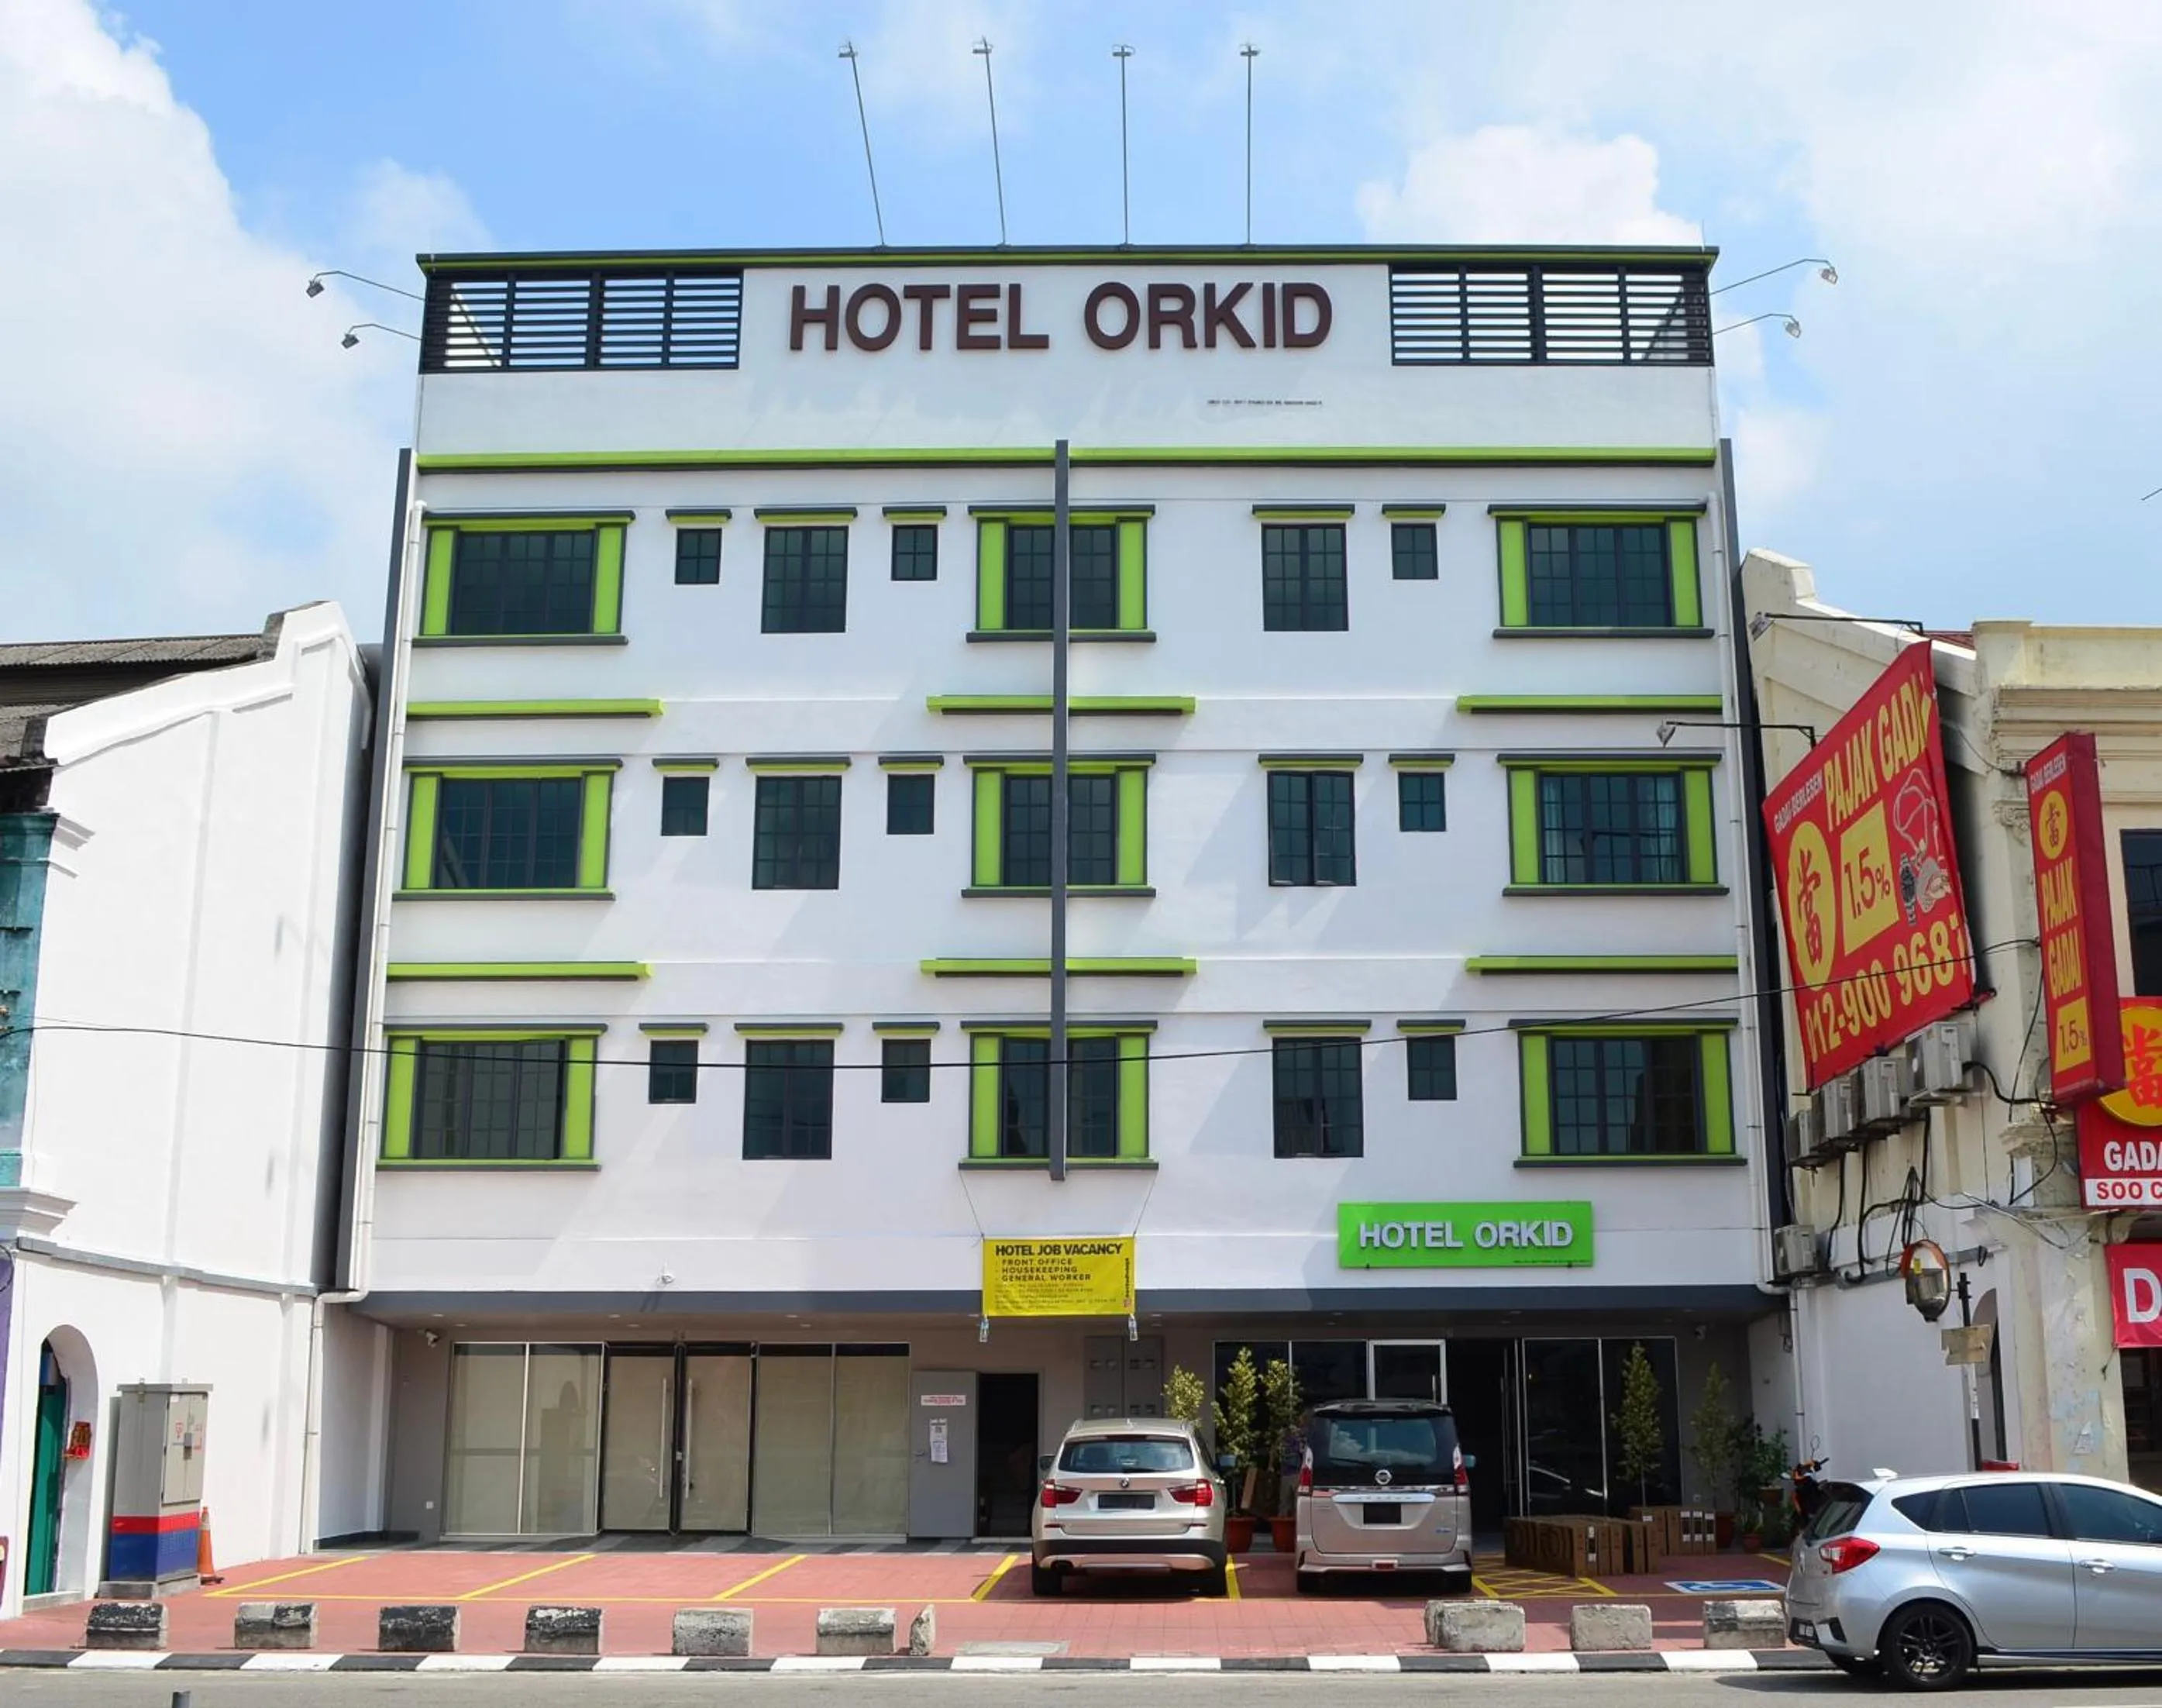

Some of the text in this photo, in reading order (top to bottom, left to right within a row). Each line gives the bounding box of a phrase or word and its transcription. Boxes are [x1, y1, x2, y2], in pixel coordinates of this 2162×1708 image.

[790, 282, 1332, 351] HOTEL ORKID
[1824, 719, 1878, 832] PAJAK
[1844, 847, 1890, 919] 1.5%
[2041, 856, 2078, 931] PAJAK
[2048, 926, 2082, 1000] GADAI
[2096, 1181, 2143, 1200] SOO
[996, 1243, 1123, 1256] HOTEL JOB VACANCY
[1359, 1220, 1573, 1248] HOTEL ORKID
